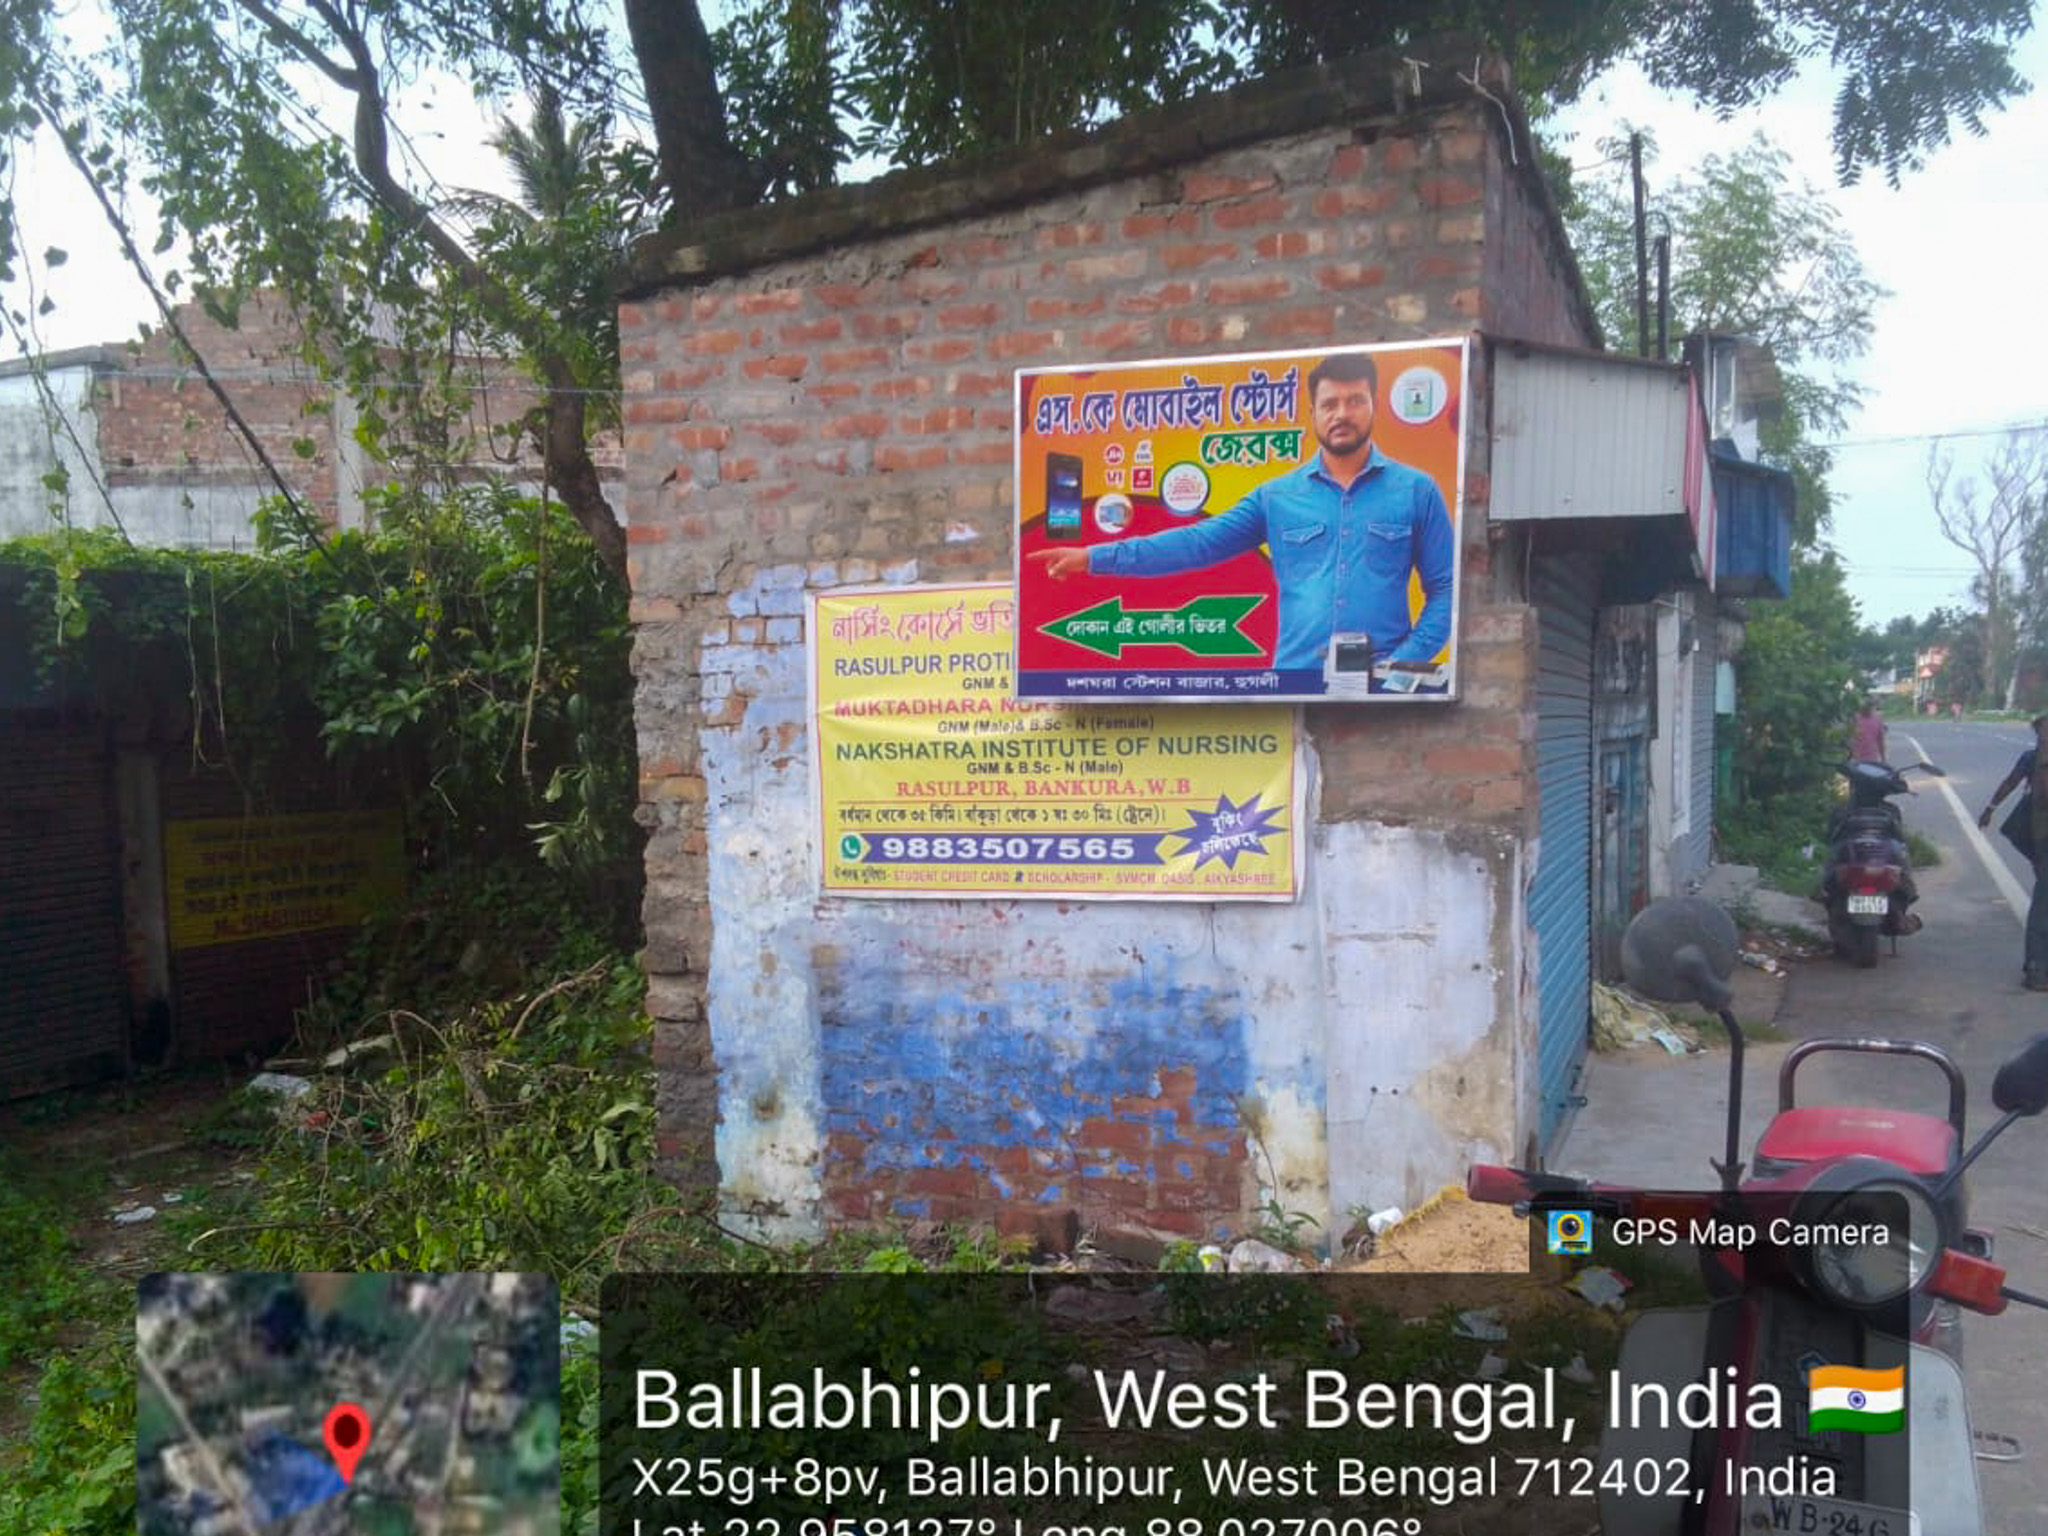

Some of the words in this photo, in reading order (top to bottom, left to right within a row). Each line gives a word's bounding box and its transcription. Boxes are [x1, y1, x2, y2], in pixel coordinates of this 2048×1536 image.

[1122, 374, 1223, 427] মোবাইল
[1113, 616, 1135, 636] এই
[834, 654, 941, 676] RASULPUR
[962, 677, 994, 690] GNM
[999, 677, 1009, 689] &
[834, 697, 992, 717] MUKTADHARA
[938, 721, 970, 734] GNM
[1076, 718, 1086, 730] N
[1091, 714, 1154, 733] (Female)
[836, 741, 976, 761] NAKSHATRA
[982, 737, 1107, 759] INSTITUTE
[1115, 737, 1150, 756] OF
[1158, 734, 1278, 755] NURSING
[967, 762, 999, 775] GNM
[1004, 762, 1014, 774] &
[1065, 761, 1075, 774] N
[1080, 760, 1123, 776] (Male)
[897, 780, 1017, 799] RASULPUR,
[882, 837, 1135, 860] 9883507565
